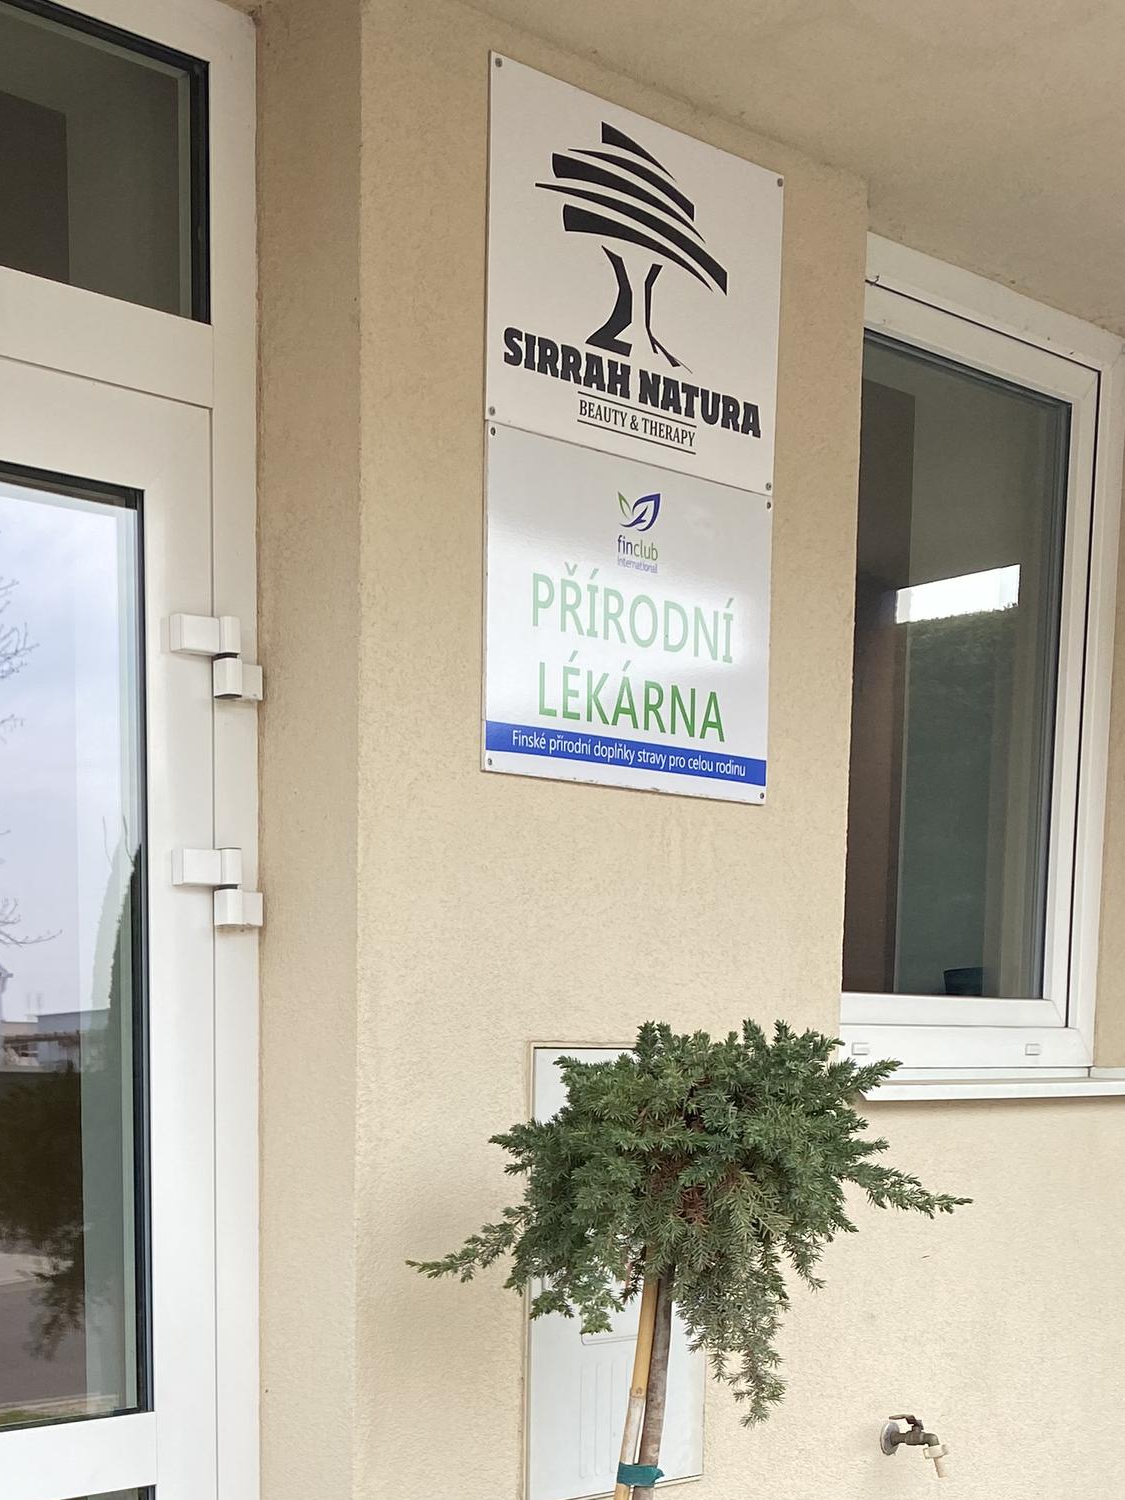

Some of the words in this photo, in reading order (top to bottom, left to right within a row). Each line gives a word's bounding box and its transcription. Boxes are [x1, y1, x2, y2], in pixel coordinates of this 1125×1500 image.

[503, 326, 631, 400] SIRRAH
[638, 368, 762, 439] NATURA
[579, 399, 627, 431] BEAUTY
[629, 415, 639, 431] &
[642, 417, 696, 448] THERAPY
[617, 534, 658, 561] finclub
[531, 561, 735, 664] PŘÍRODNÍ
[538, 650, 725, 743] LÉKÁRNA
[512, 729, 547, 750] Finské
[549, 734, 592, 759] přírodní
[593, 740, 635, 768] doplňky
[637, 748, 667, 769] stravy
[669, 754, 685, 772] pro
[688, 752, 714, 773] celou
[716, 755, 746, 777] rodinu
